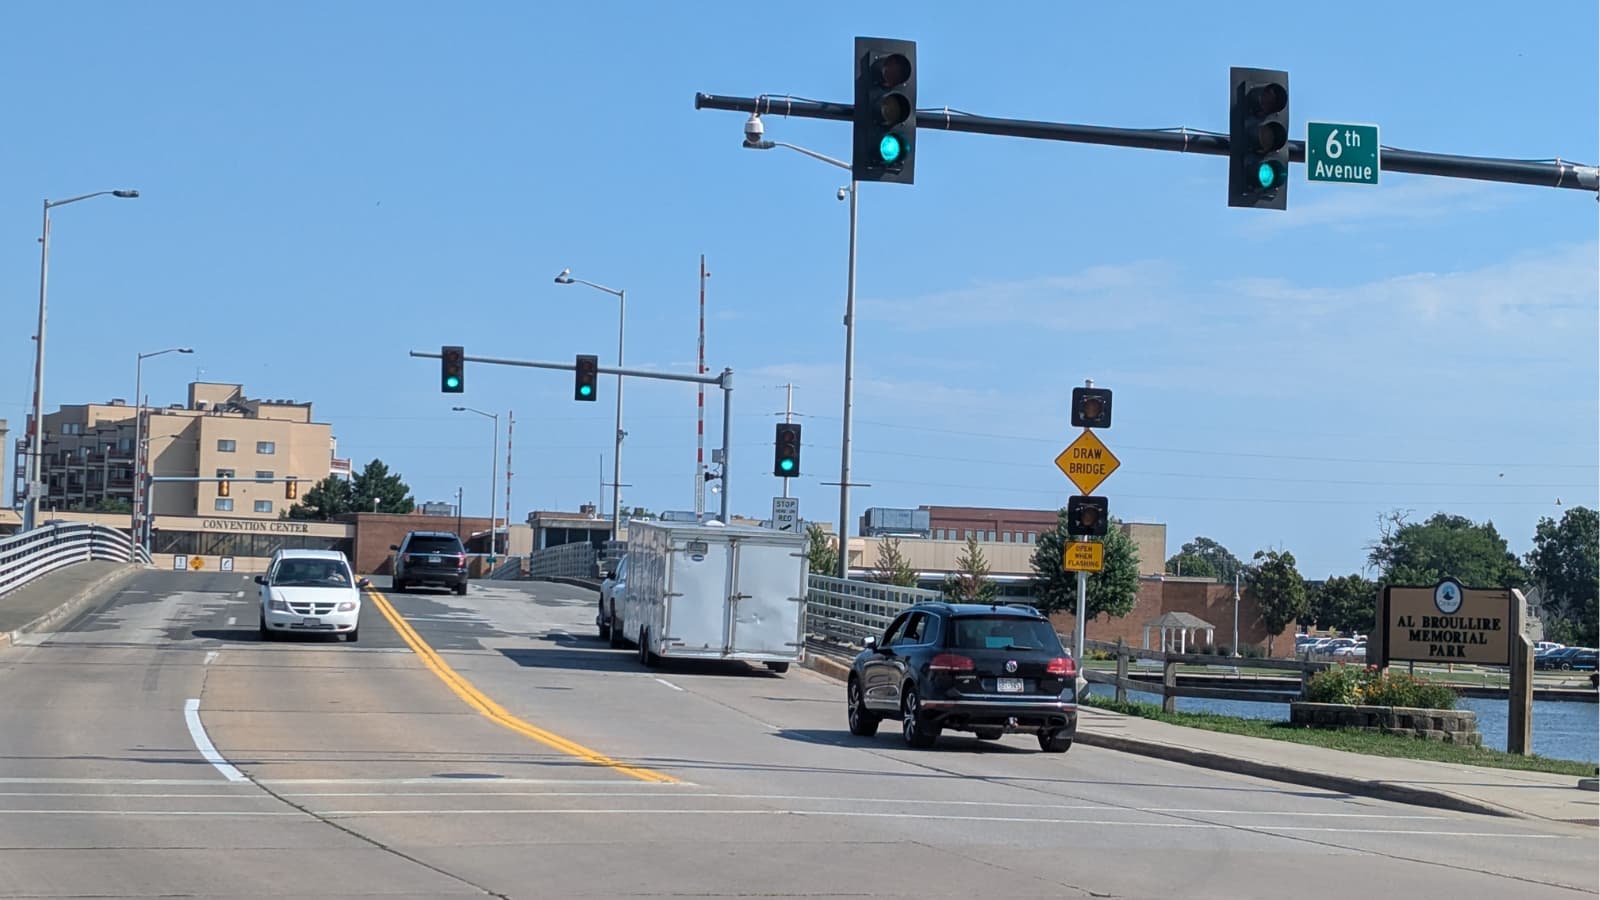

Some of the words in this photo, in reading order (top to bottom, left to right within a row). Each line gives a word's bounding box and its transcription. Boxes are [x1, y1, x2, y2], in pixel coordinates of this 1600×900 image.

[1325, 128, 1361, 159] 6th
[1315, 159, 1372, 180] Avenue
[1073, 447, 1102, 459] DRAW
[1069, 462, 1106, 475] BRIDGE
[776, 500, 796, 508] STOP
[202, 519, 267, 532] CONVENTION
[269, 521, 309, 533] CENTER
[1067, 559, 1100, 568] FLASHING
[1397, 615, 1416, 628] AL
[1421, 615, 1502, 631] BROULLIRE
[1408, 629, 1488, 645] MEMORIAL
[1429, 644, 1466, 658] PARK
